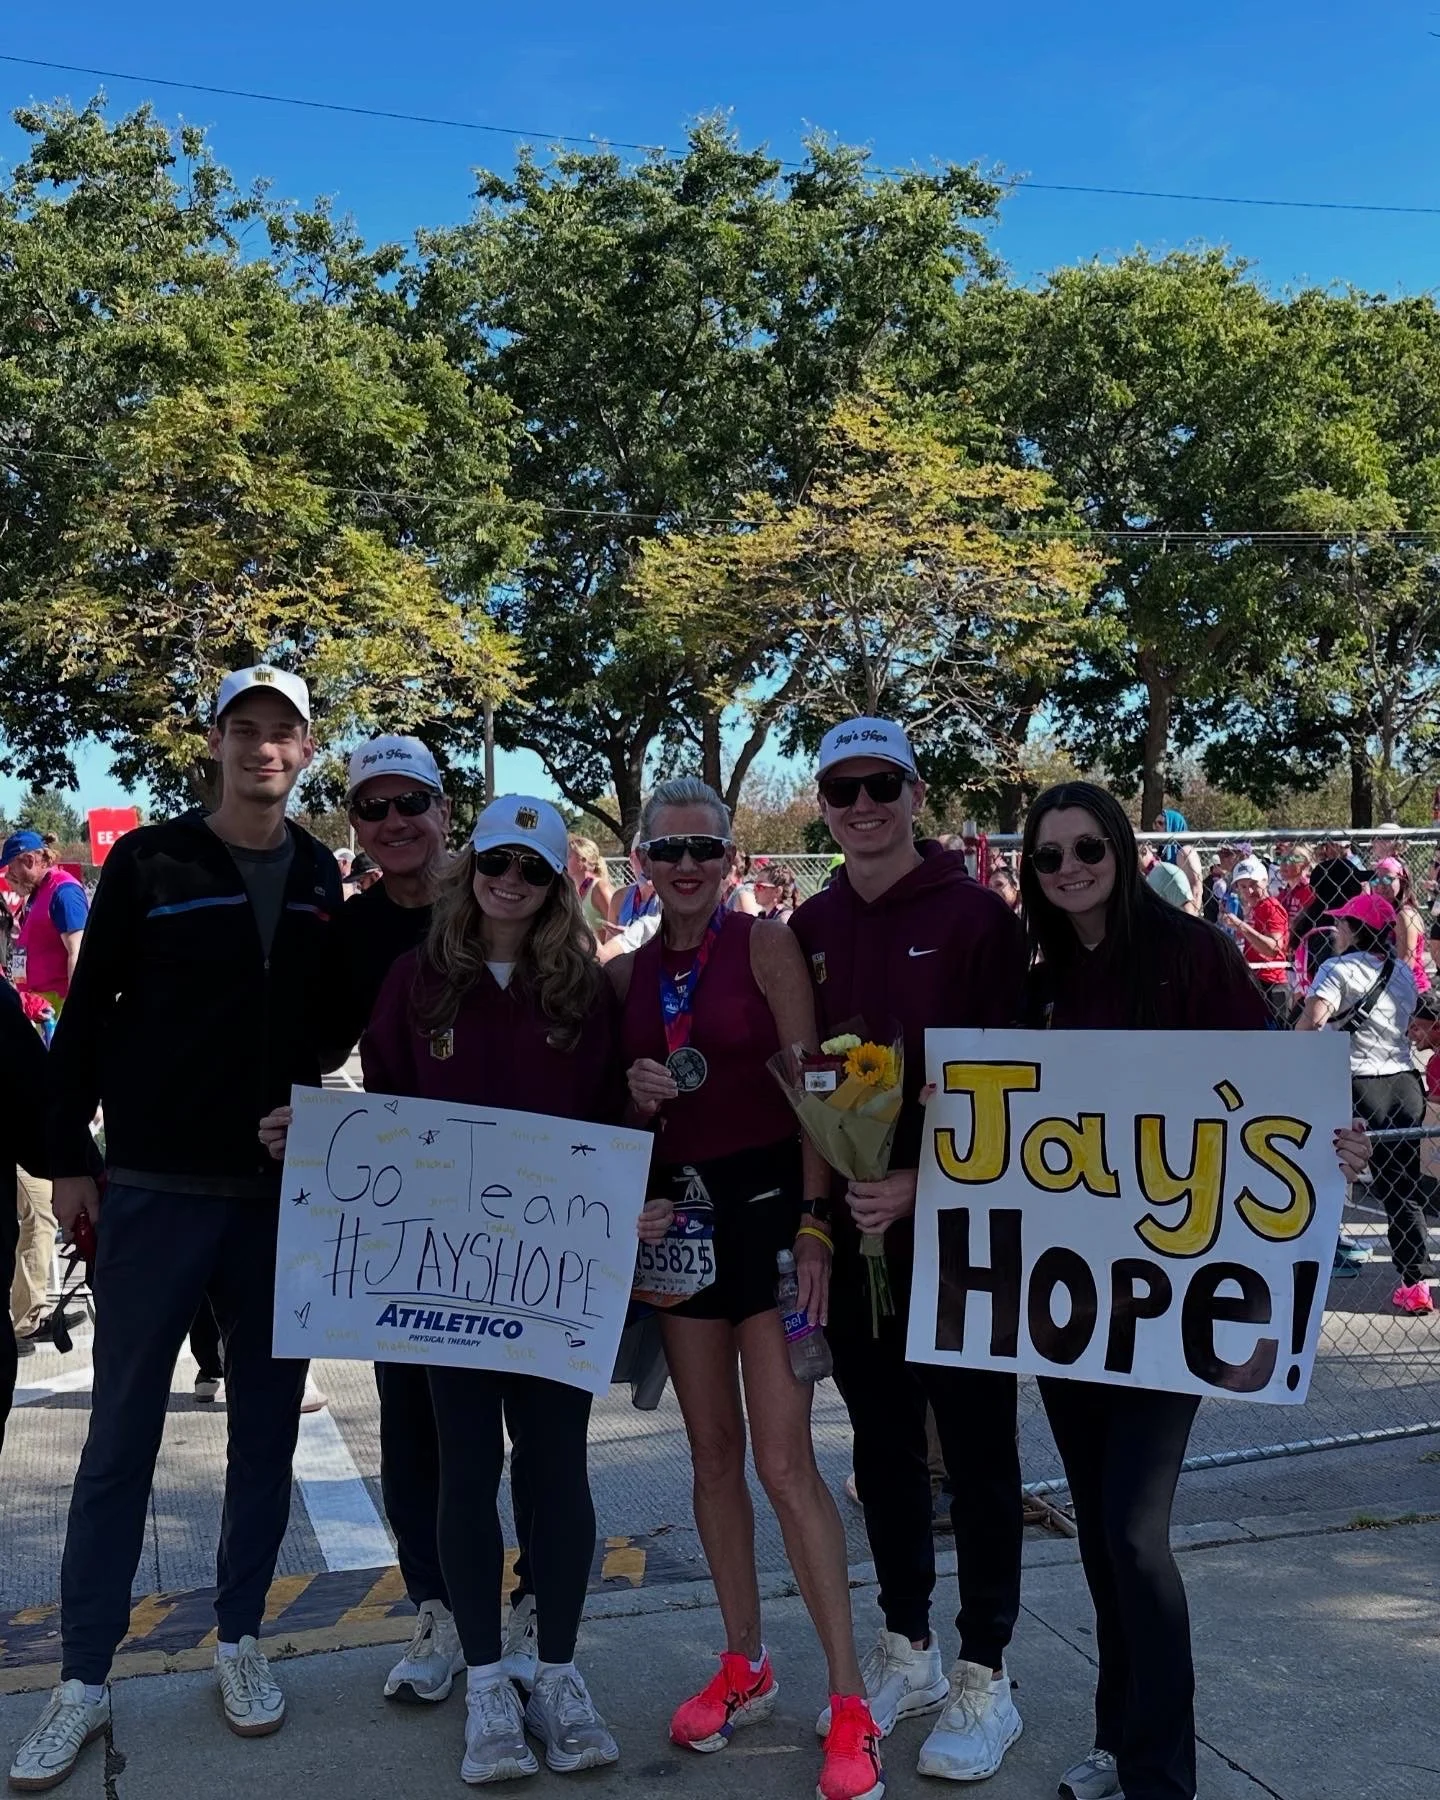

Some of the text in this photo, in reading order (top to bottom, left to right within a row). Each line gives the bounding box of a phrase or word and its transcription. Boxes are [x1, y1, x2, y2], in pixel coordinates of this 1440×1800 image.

[326, 1108, 611, 1239] Go Team
[934, 1059, 1316, 1259] Jay's
[321, 1212, 604, 1319] #JAYSHOPE
[375, 1303, 524, 1340] ATHLETICO
[408, 1334, 482, 1347] PHYSICAL THERAPY
